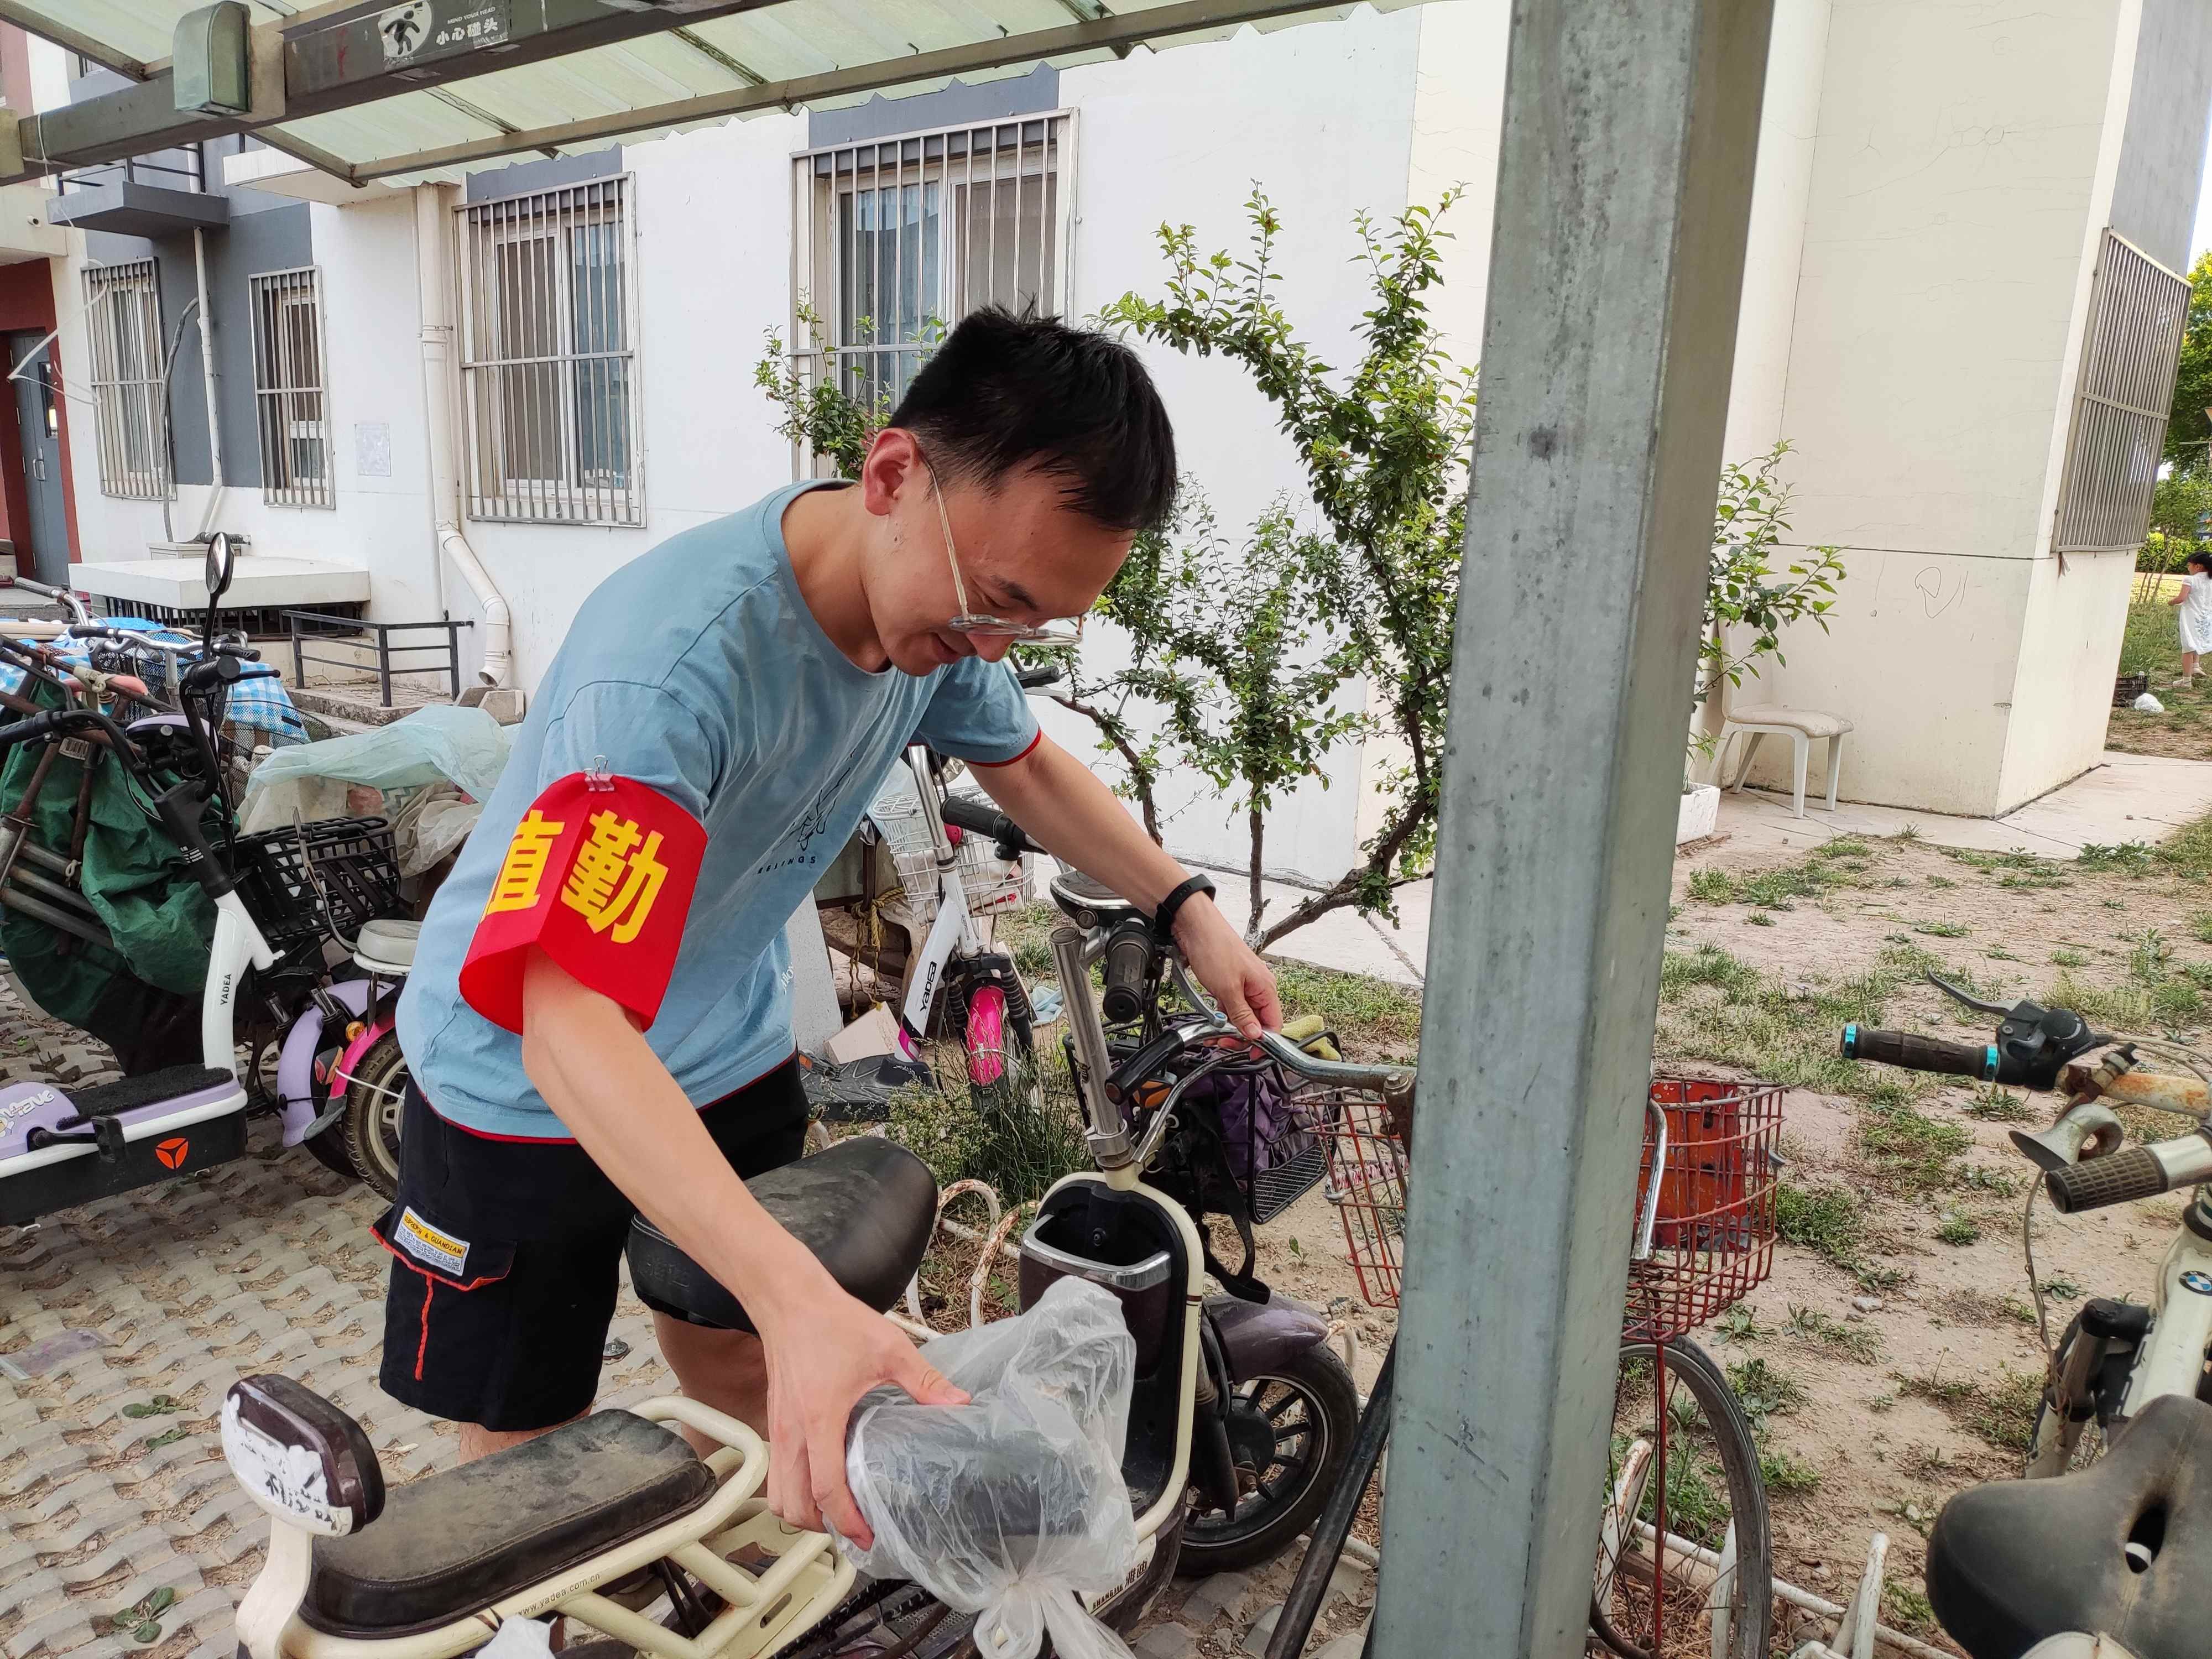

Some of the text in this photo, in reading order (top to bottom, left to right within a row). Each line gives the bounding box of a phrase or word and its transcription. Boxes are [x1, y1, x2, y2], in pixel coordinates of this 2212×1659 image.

[447, 6, 496, 24] MIND YOUR HEAD
[436, 17, 498, 45] 小心碰头
[220, 973, 232, 1005] YADEA
